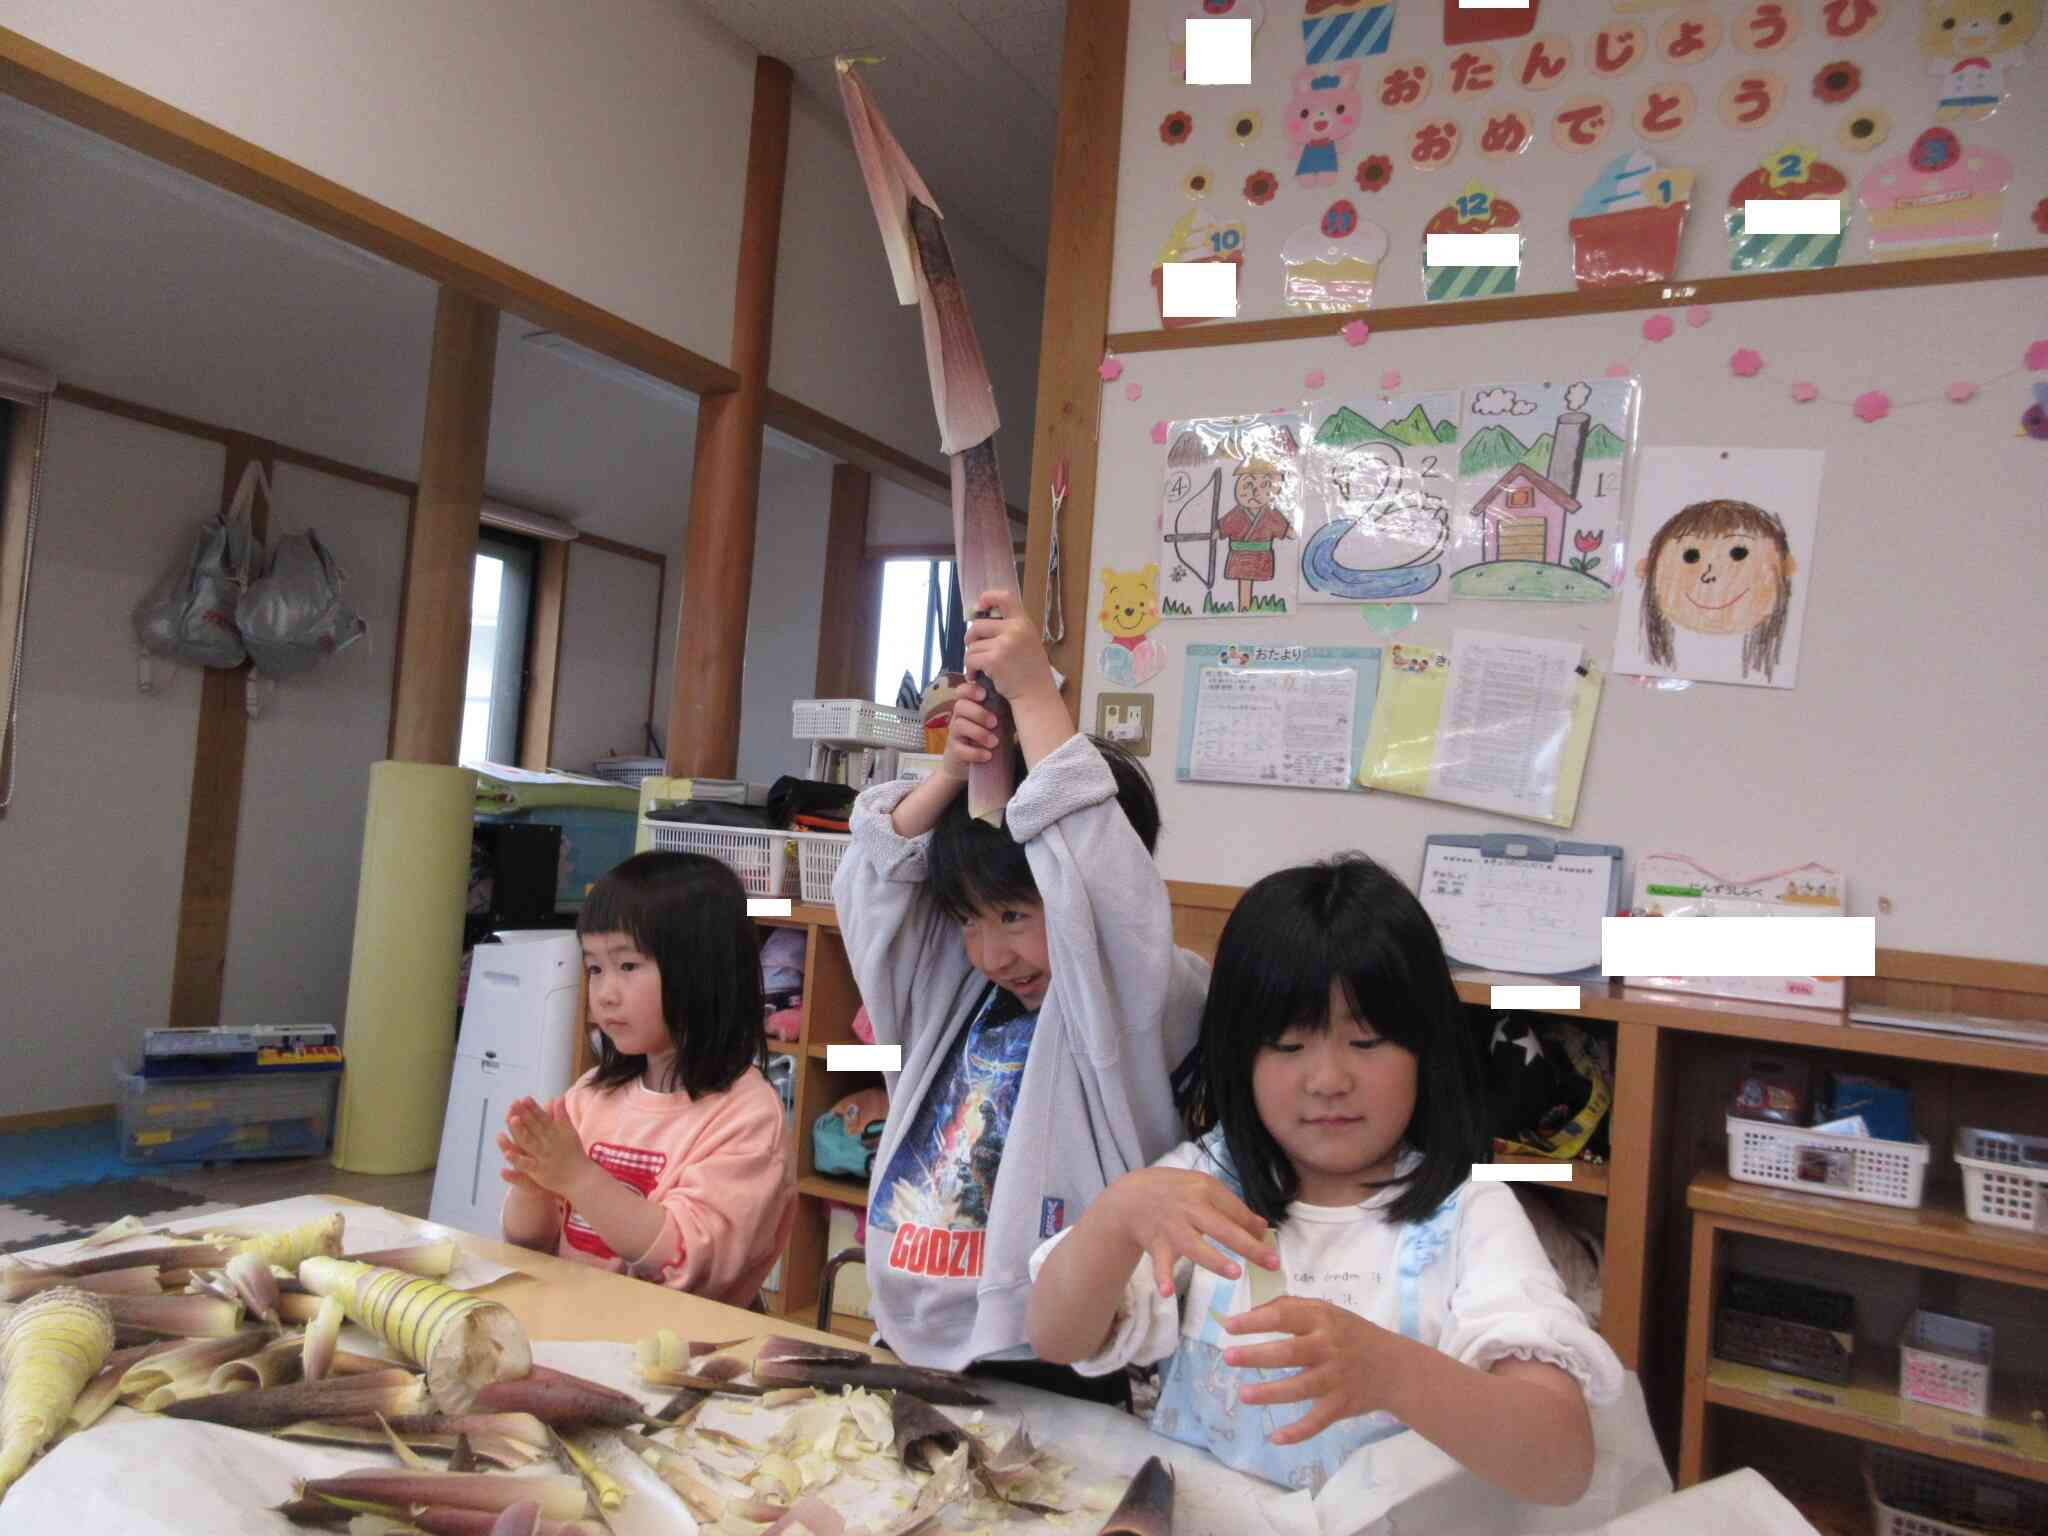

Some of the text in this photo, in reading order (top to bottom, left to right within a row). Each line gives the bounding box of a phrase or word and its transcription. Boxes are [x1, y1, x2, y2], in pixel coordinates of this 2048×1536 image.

[1411, 79, 1771, 162] おめでとう
[1777, 154, 1803, 178] 2
[1658, 179, 1672, 204] 1
[1455, 192, 1489, 218] 12
[1210, 229, 1240, 253] 10
[1420, 455, 1441, 480] 2
[1255, 647, 1302, 662] おたより
[889, 1220, 985, 1278] GODZI
